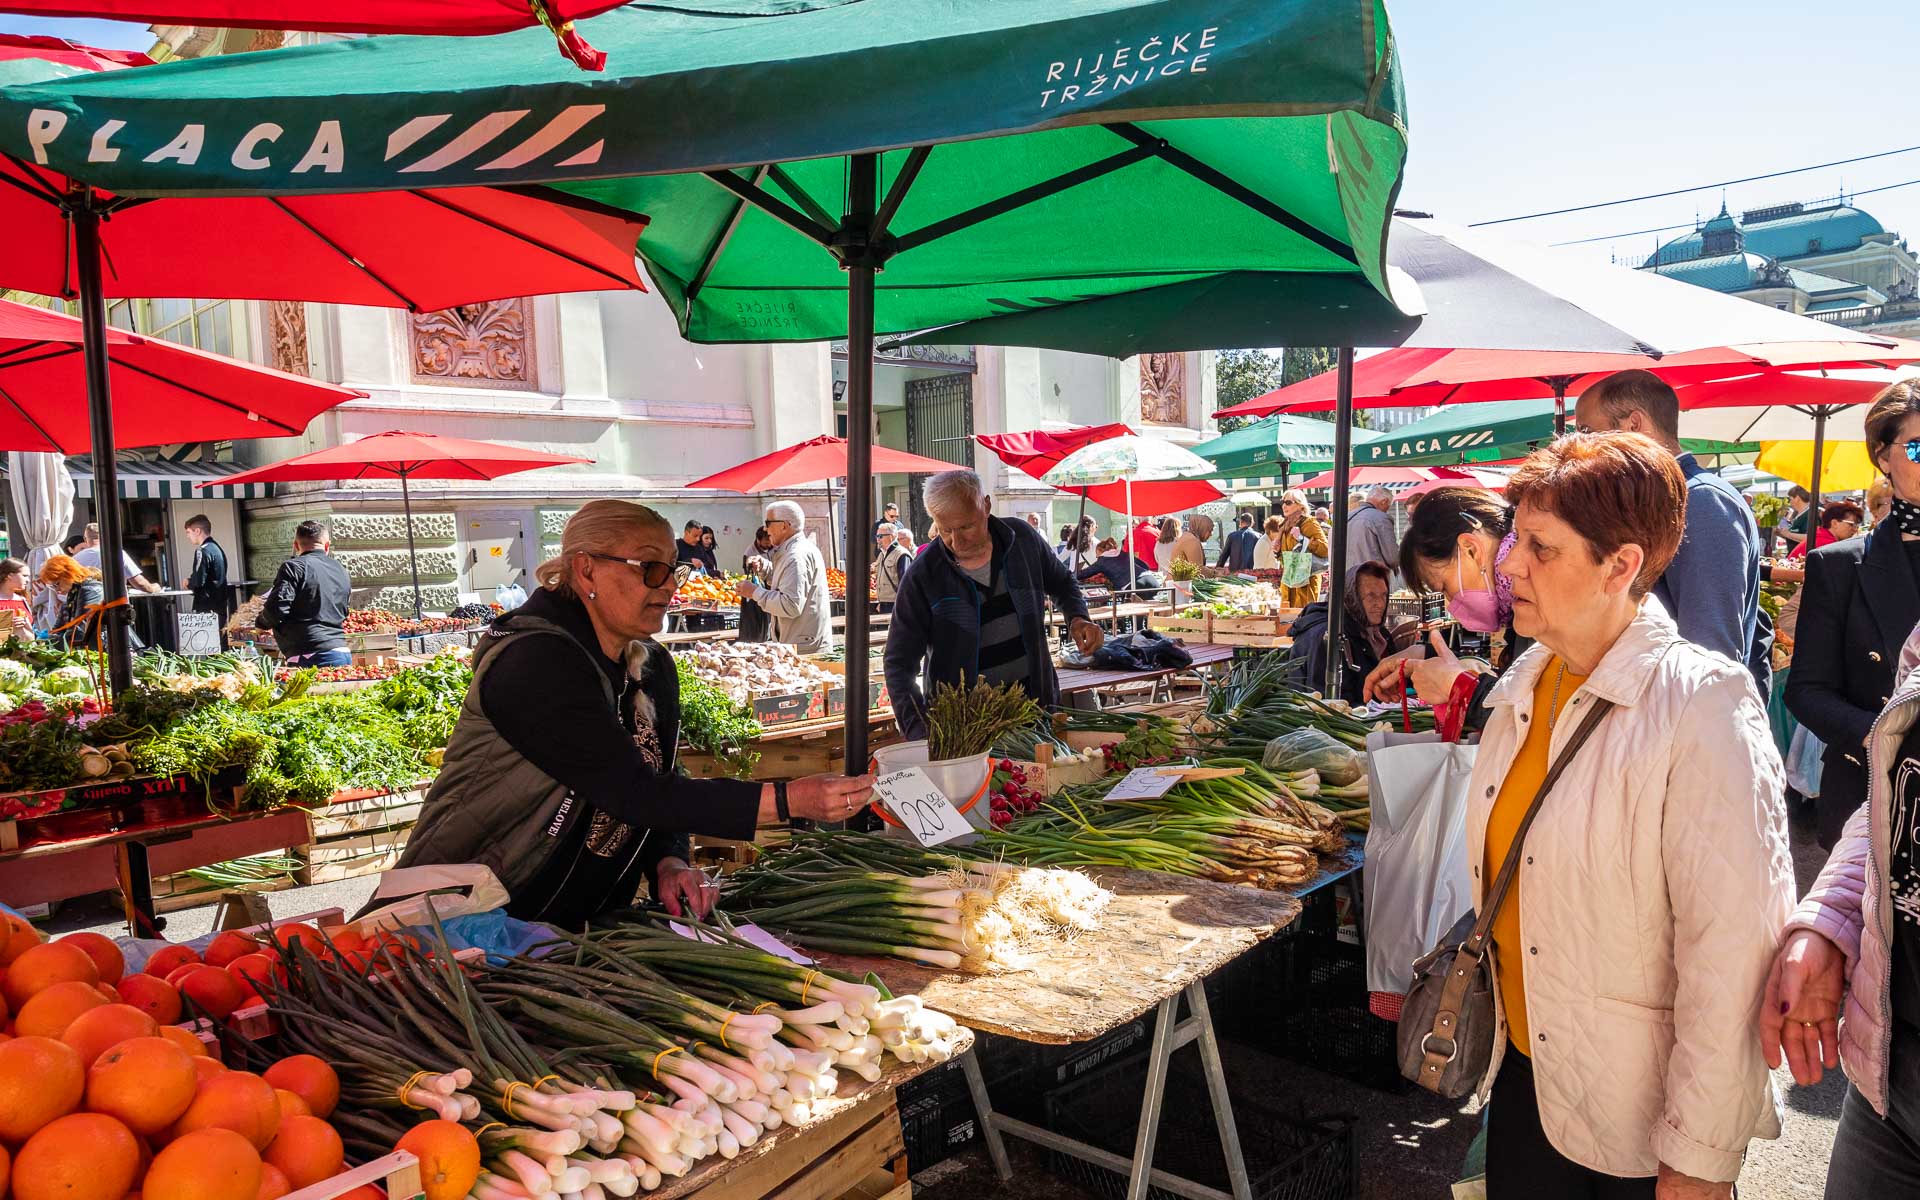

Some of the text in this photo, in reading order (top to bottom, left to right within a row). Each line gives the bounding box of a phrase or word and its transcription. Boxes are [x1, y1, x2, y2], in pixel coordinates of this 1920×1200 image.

[1046, 27, 1218, 82] RIJEČKE
[1041, 53, 1211, 108] TRŽNICE
[27, 108, 345, 174] PLACA
[1372, 438, 1441, 459] PLACA
[833, 701, 845, 712] Lu
[83, 785, 132, 800] Quality
